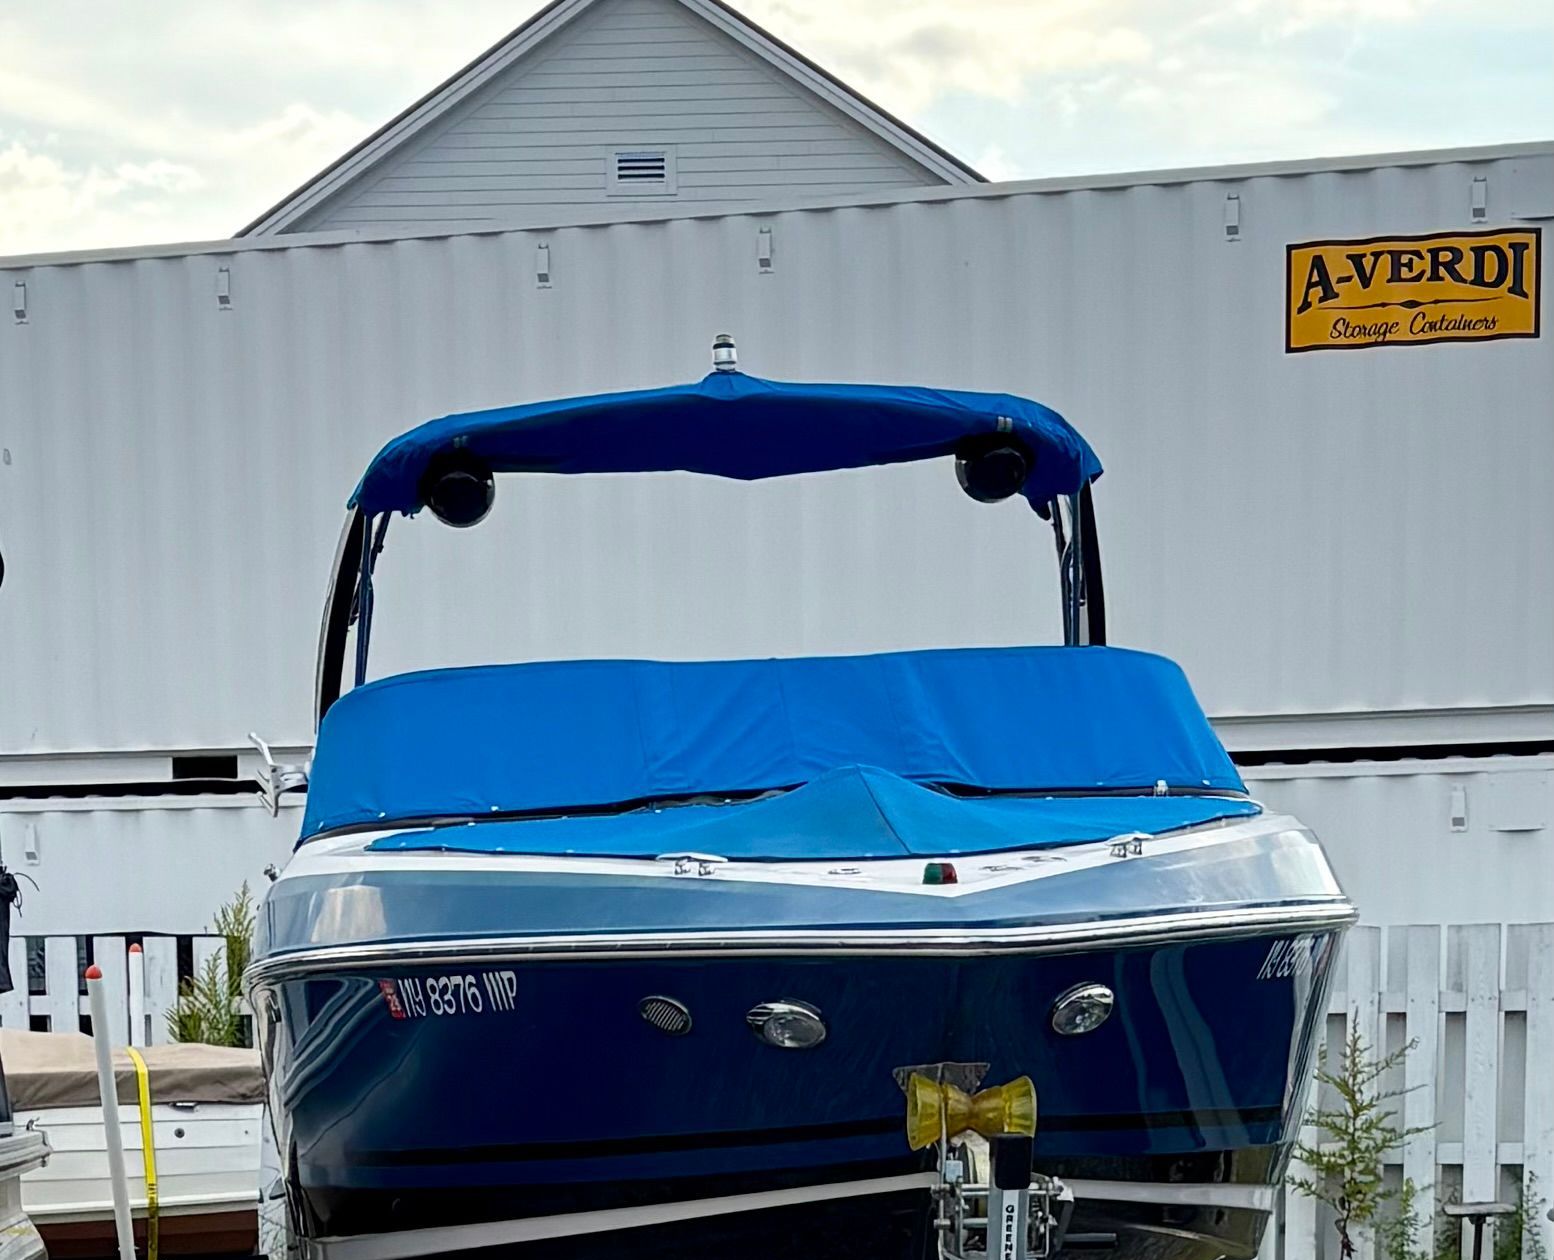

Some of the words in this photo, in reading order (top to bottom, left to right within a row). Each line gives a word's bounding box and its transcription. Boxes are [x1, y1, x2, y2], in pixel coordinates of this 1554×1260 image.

[1297, 242, 1530, 314] A-VERDI
[1330, 317, 1400, 342] Storage
[1409, 311, 1499, 336] Containers
[426, 975, 482, 1015] 8376
[1004, 1204, 1015, 1260] GREENE
